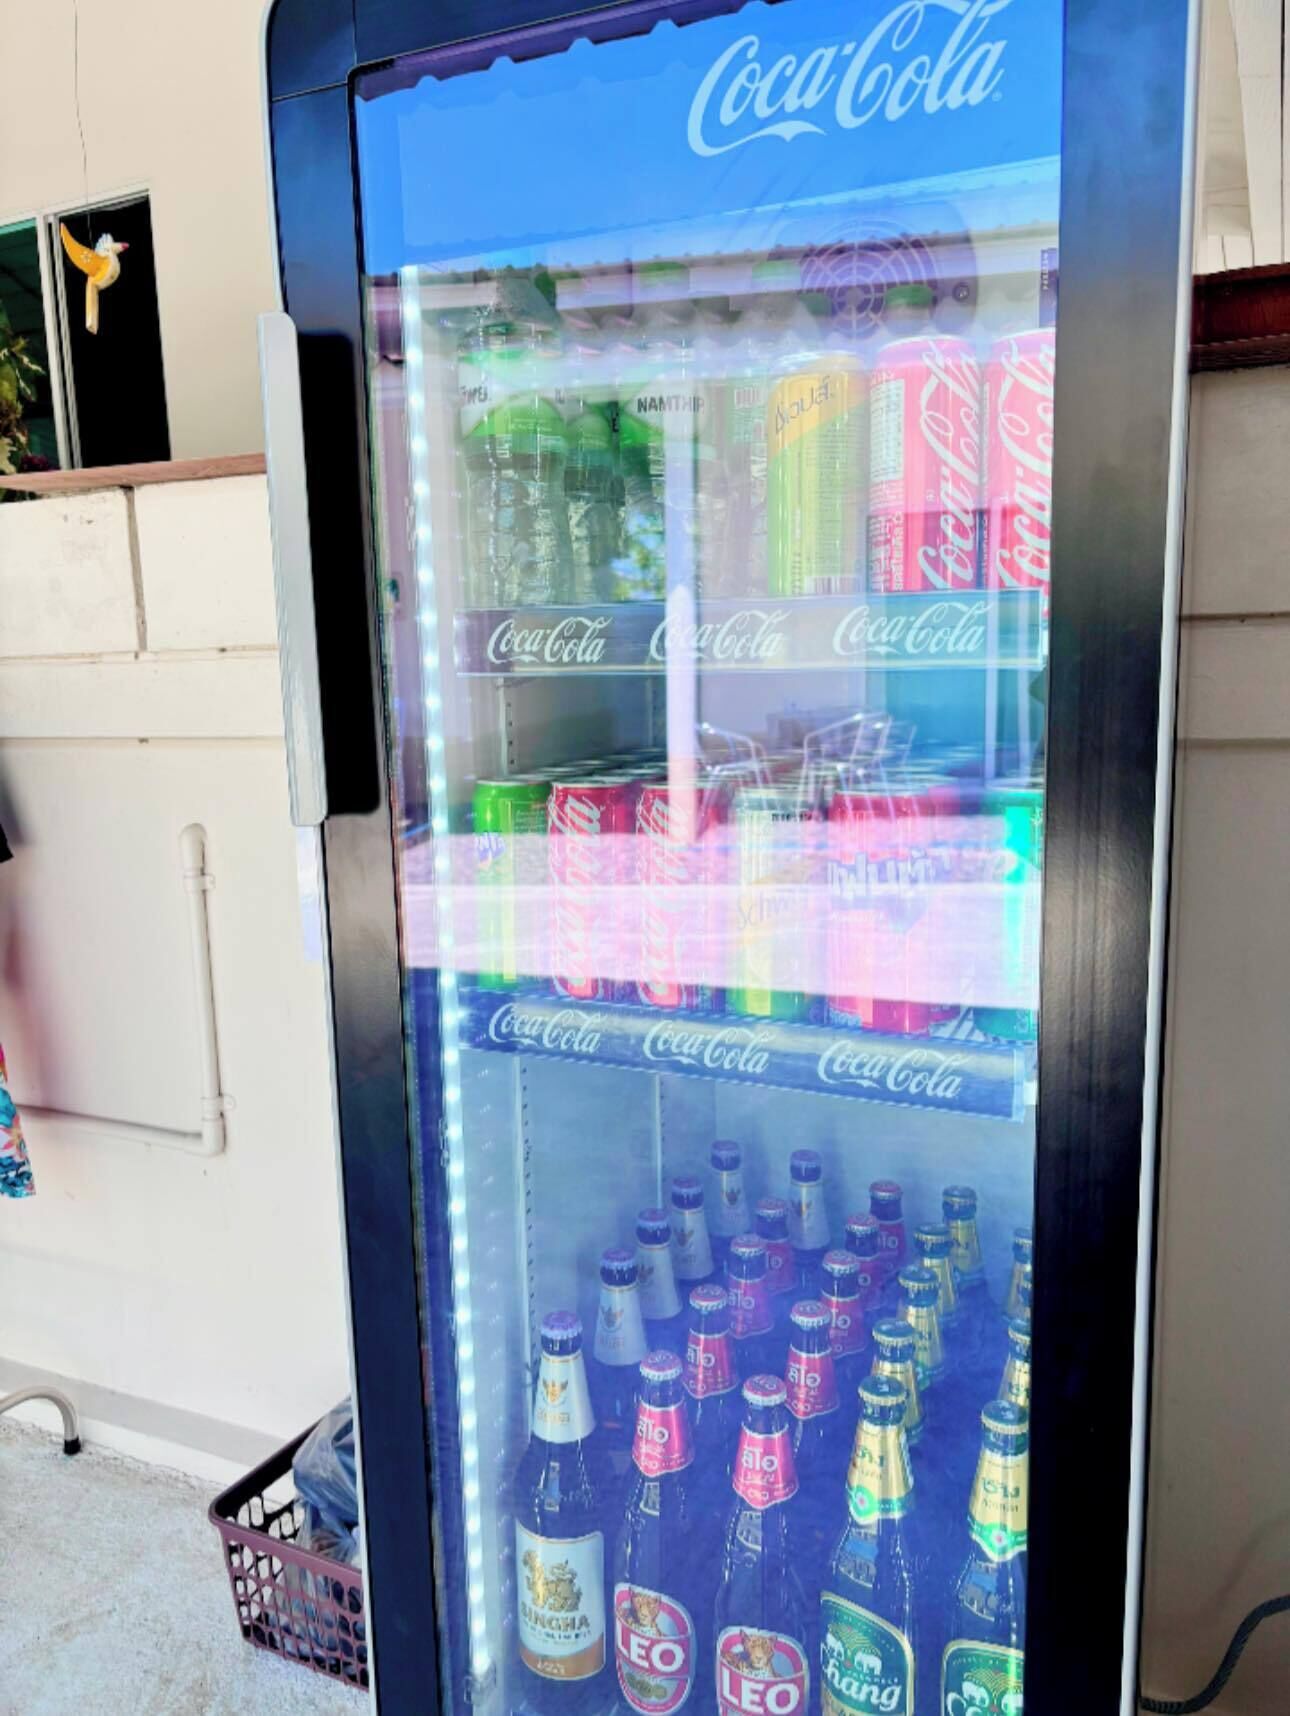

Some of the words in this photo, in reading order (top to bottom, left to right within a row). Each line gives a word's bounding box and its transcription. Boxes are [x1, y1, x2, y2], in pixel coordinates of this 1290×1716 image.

[688, 0, 1012, 156] Coca-Cola
[637, 396, 704, 414] NAMTHIP
[487, 616, 612, 664] Coca-Cola
[650, 609, 792, 661] Coca-Cola
[833, 601, 991, 656] Coca-Cola
[489, 1003, 607, 1054] Coca-Cola
[643, 1019, 775, 1075] Coca-Cola
[817, 1040, 970, 1098] Coca-Cola
[520, 1601, 590, 1631] SINGHA
[616, 1629, 685, 1673] LEO
[721, 1669, 800, 1715] LEO
